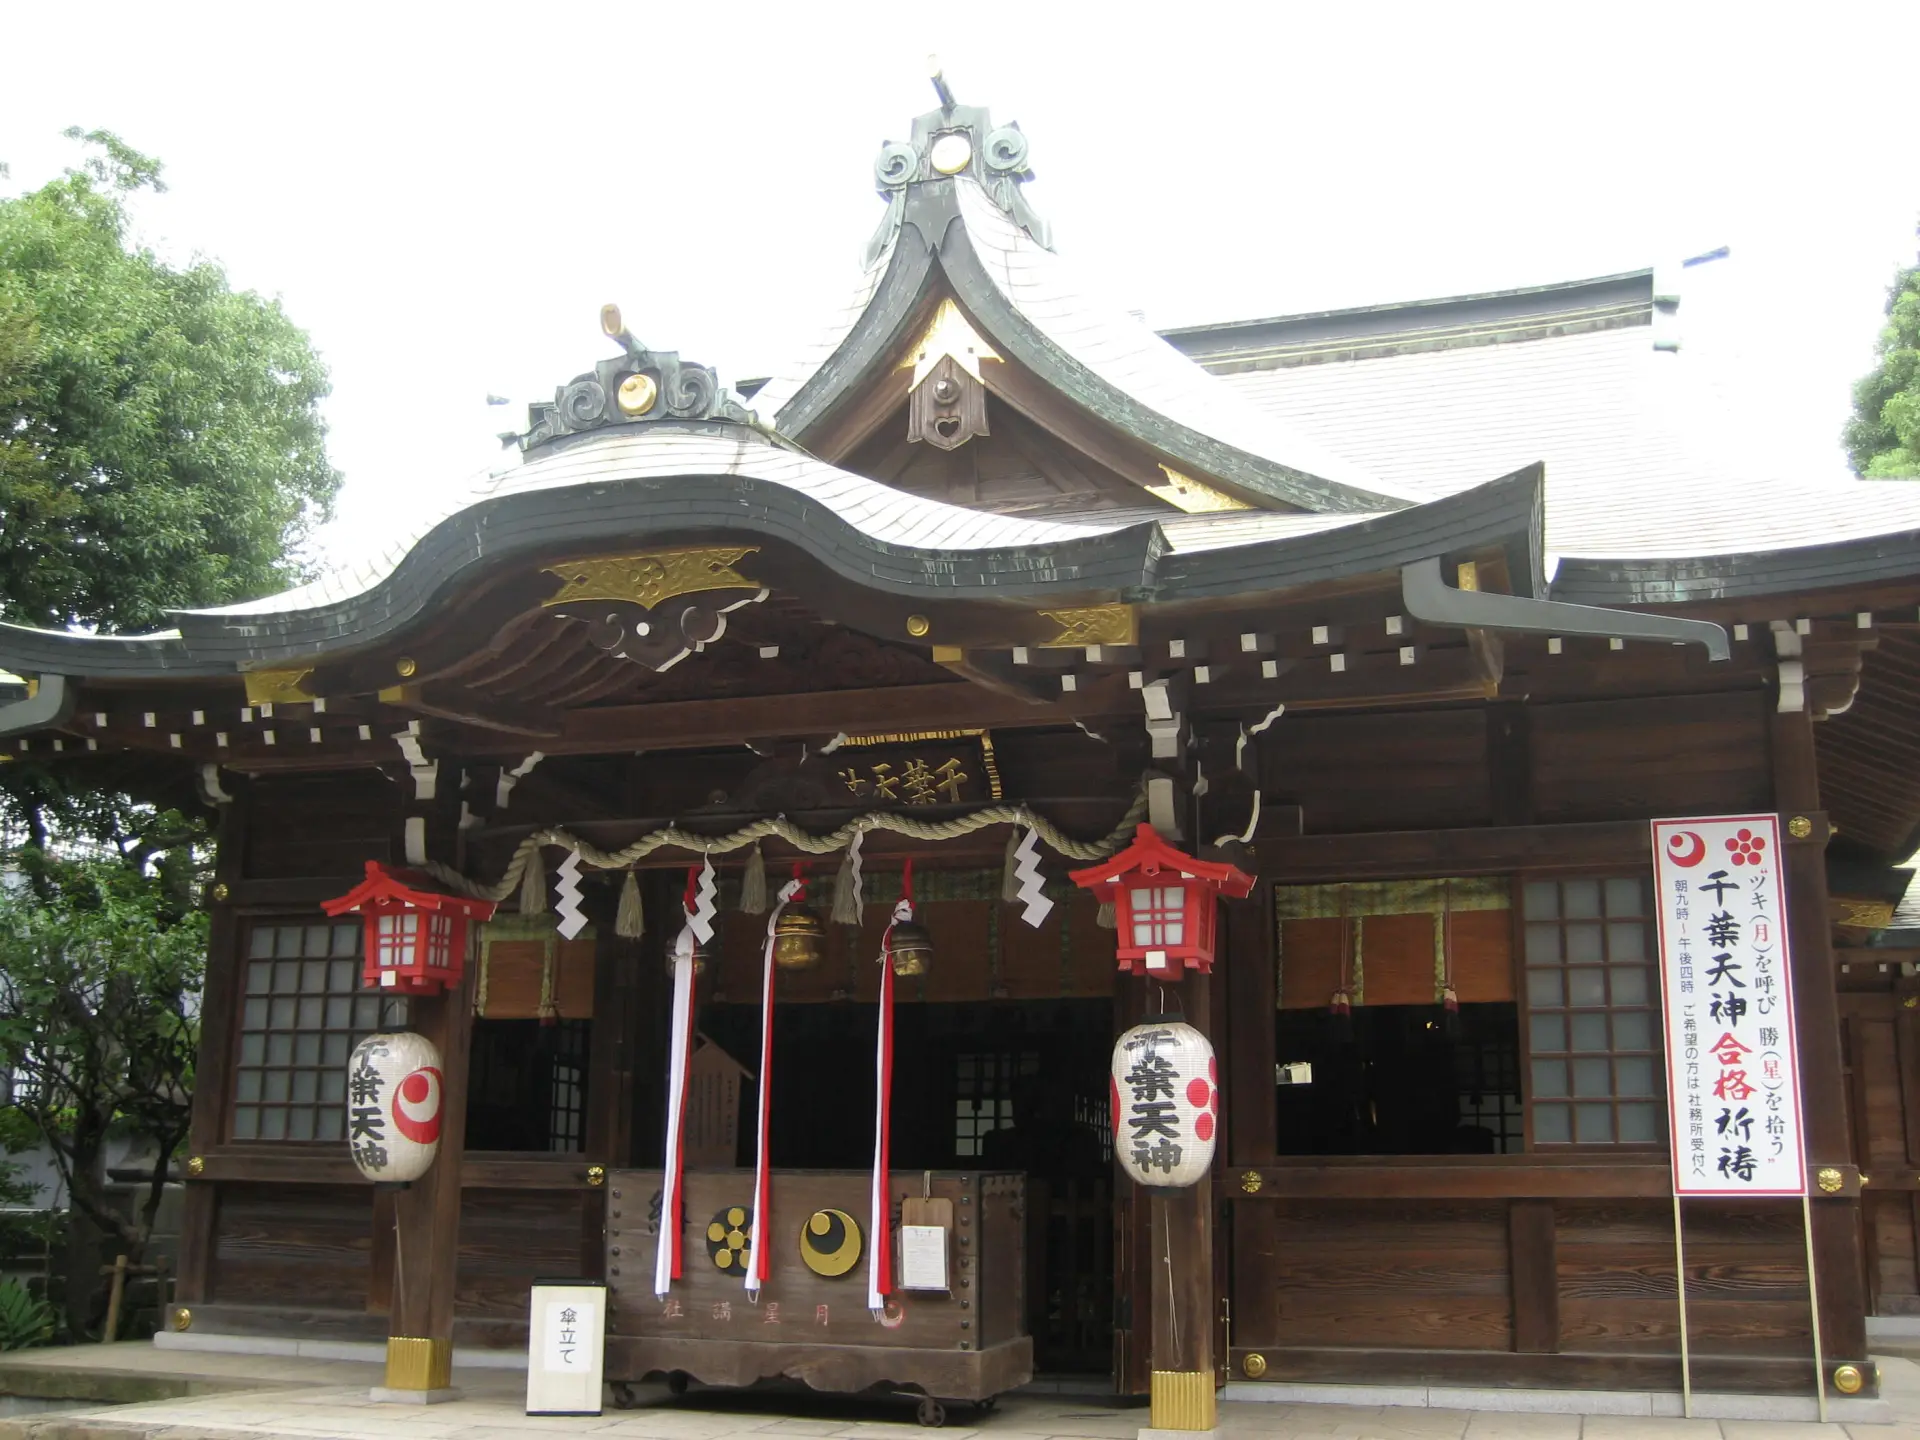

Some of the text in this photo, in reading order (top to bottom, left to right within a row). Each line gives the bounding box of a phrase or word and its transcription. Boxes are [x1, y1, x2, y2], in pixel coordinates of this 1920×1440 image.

[350, 1040, 389, 1172] 千葉天神
[1123, 1030, 1183, 1174] 千葉天神
[559, 1307, 577, 1364] 傘立て
